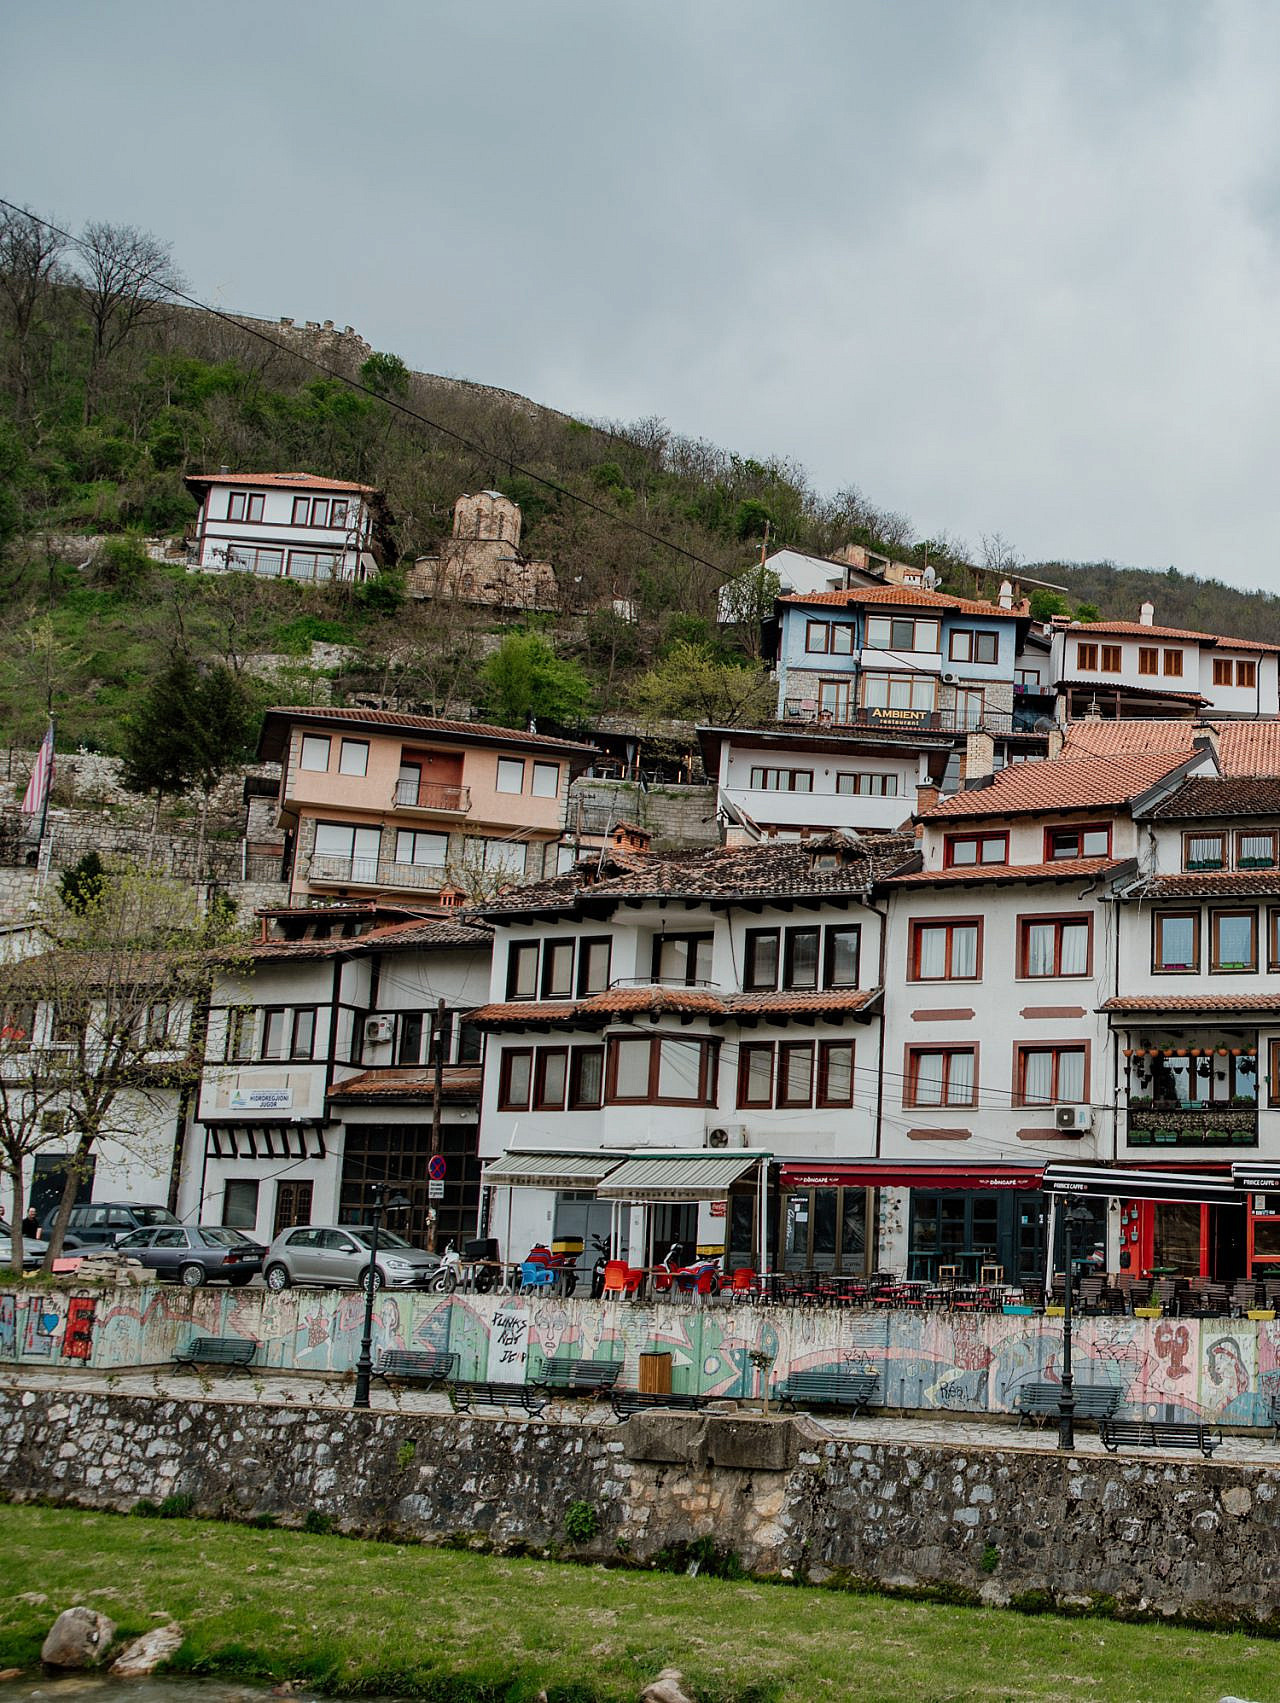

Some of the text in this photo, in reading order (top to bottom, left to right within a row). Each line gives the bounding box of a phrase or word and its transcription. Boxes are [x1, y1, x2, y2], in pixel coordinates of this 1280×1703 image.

[871, 708, 927, 720] AMBIENT
[492, 1311, 528, 1334] PUNKS
[497, 1329, 524, 1346] NOT
